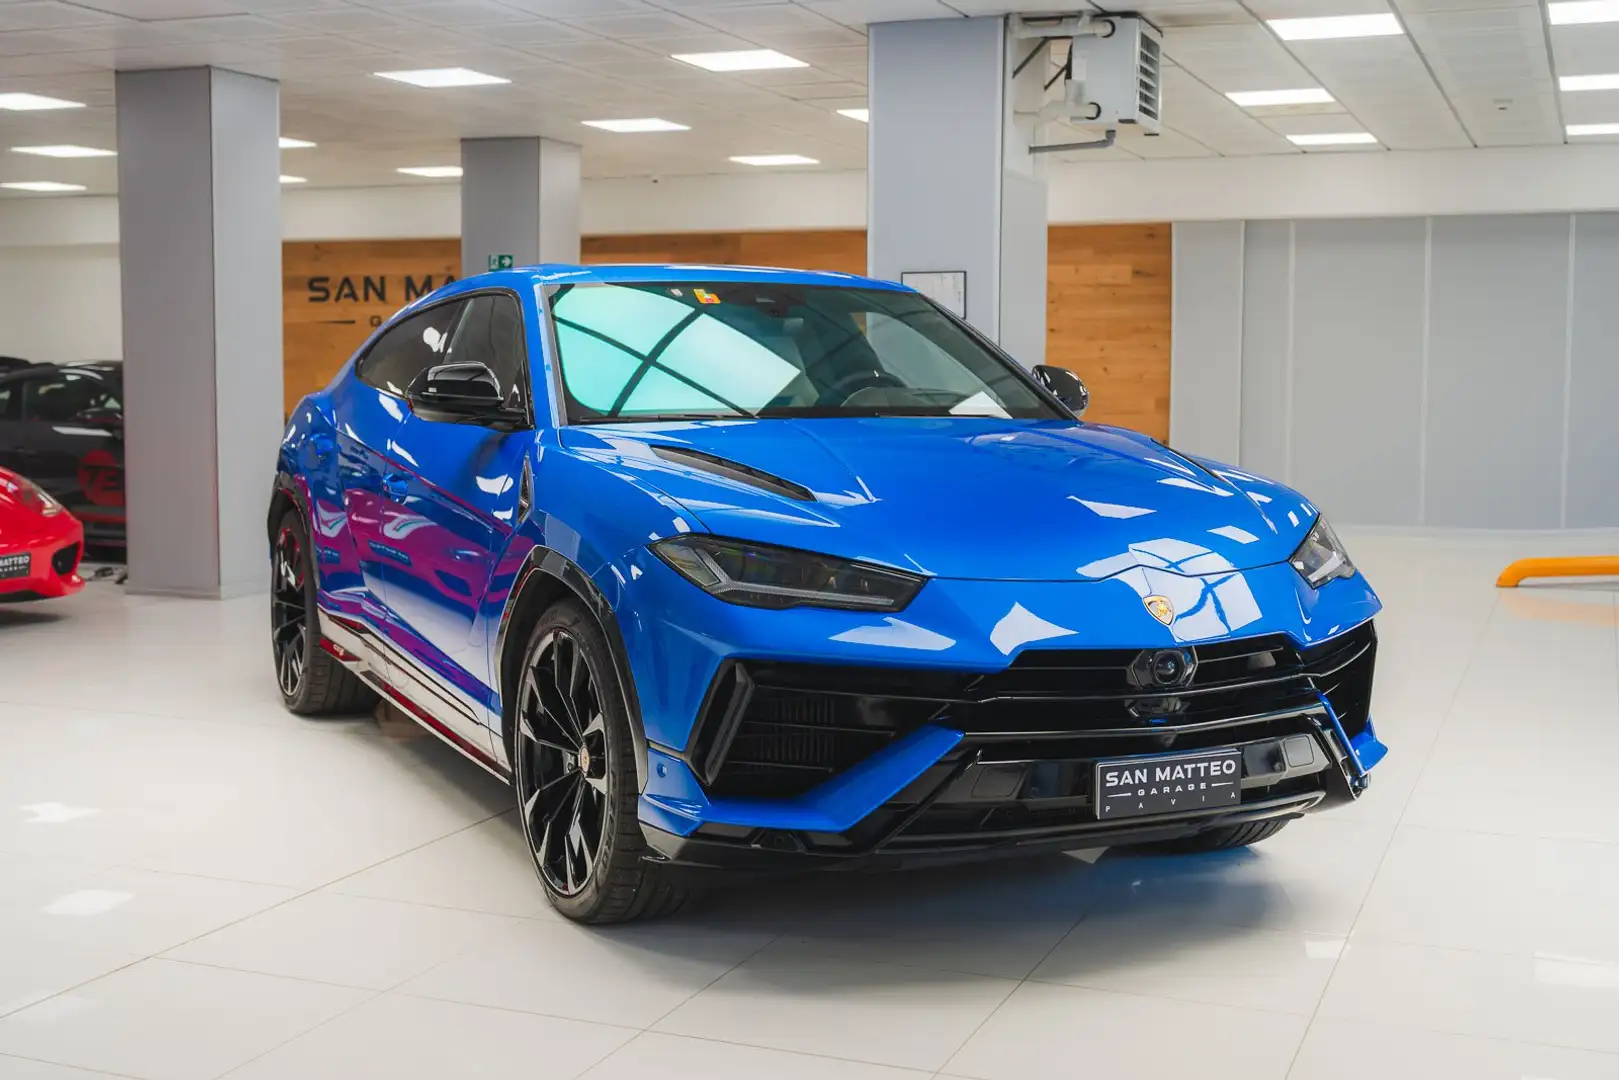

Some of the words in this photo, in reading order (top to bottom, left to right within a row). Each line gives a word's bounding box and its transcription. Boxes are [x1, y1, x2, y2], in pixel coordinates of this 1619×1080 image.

[307, 275, 387, 304] SAN
[1105, 768, 1148, 787] SAN
[1155, 759, 1236, 782] MATTEO
[1137, 782, 1206, 796] GARAGE
